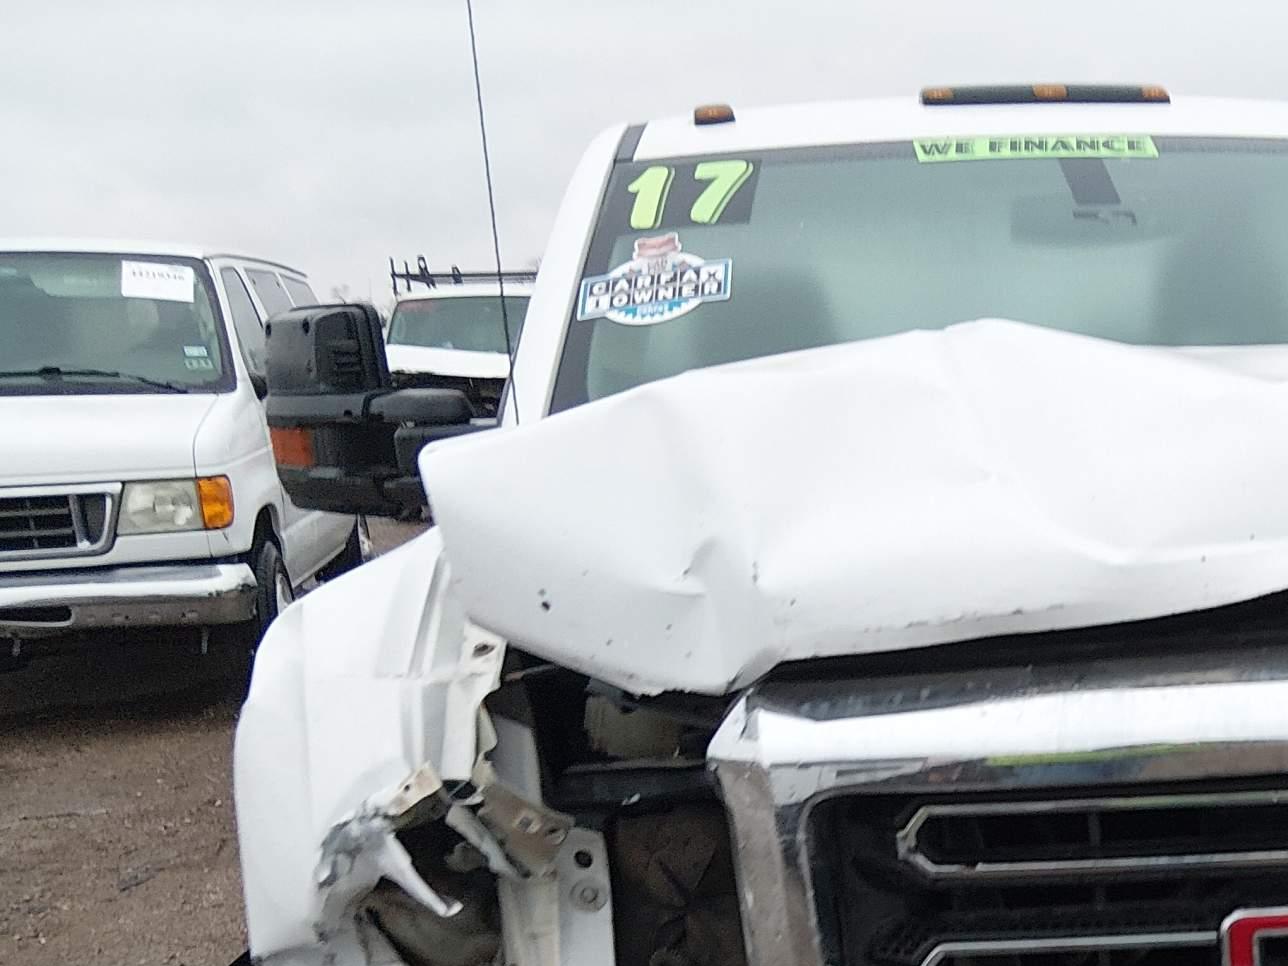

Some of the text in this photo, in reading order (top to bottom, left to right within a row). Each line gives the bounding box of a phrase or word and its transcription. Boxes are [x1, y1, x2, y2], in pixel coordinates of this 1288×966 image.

[919, 138, 1146, 156] WE FINANCE
[627, 159, 754, 230] 17
[590, 266, 723, 296] CARFAX
[611, 281, 721, 308] OWNER
